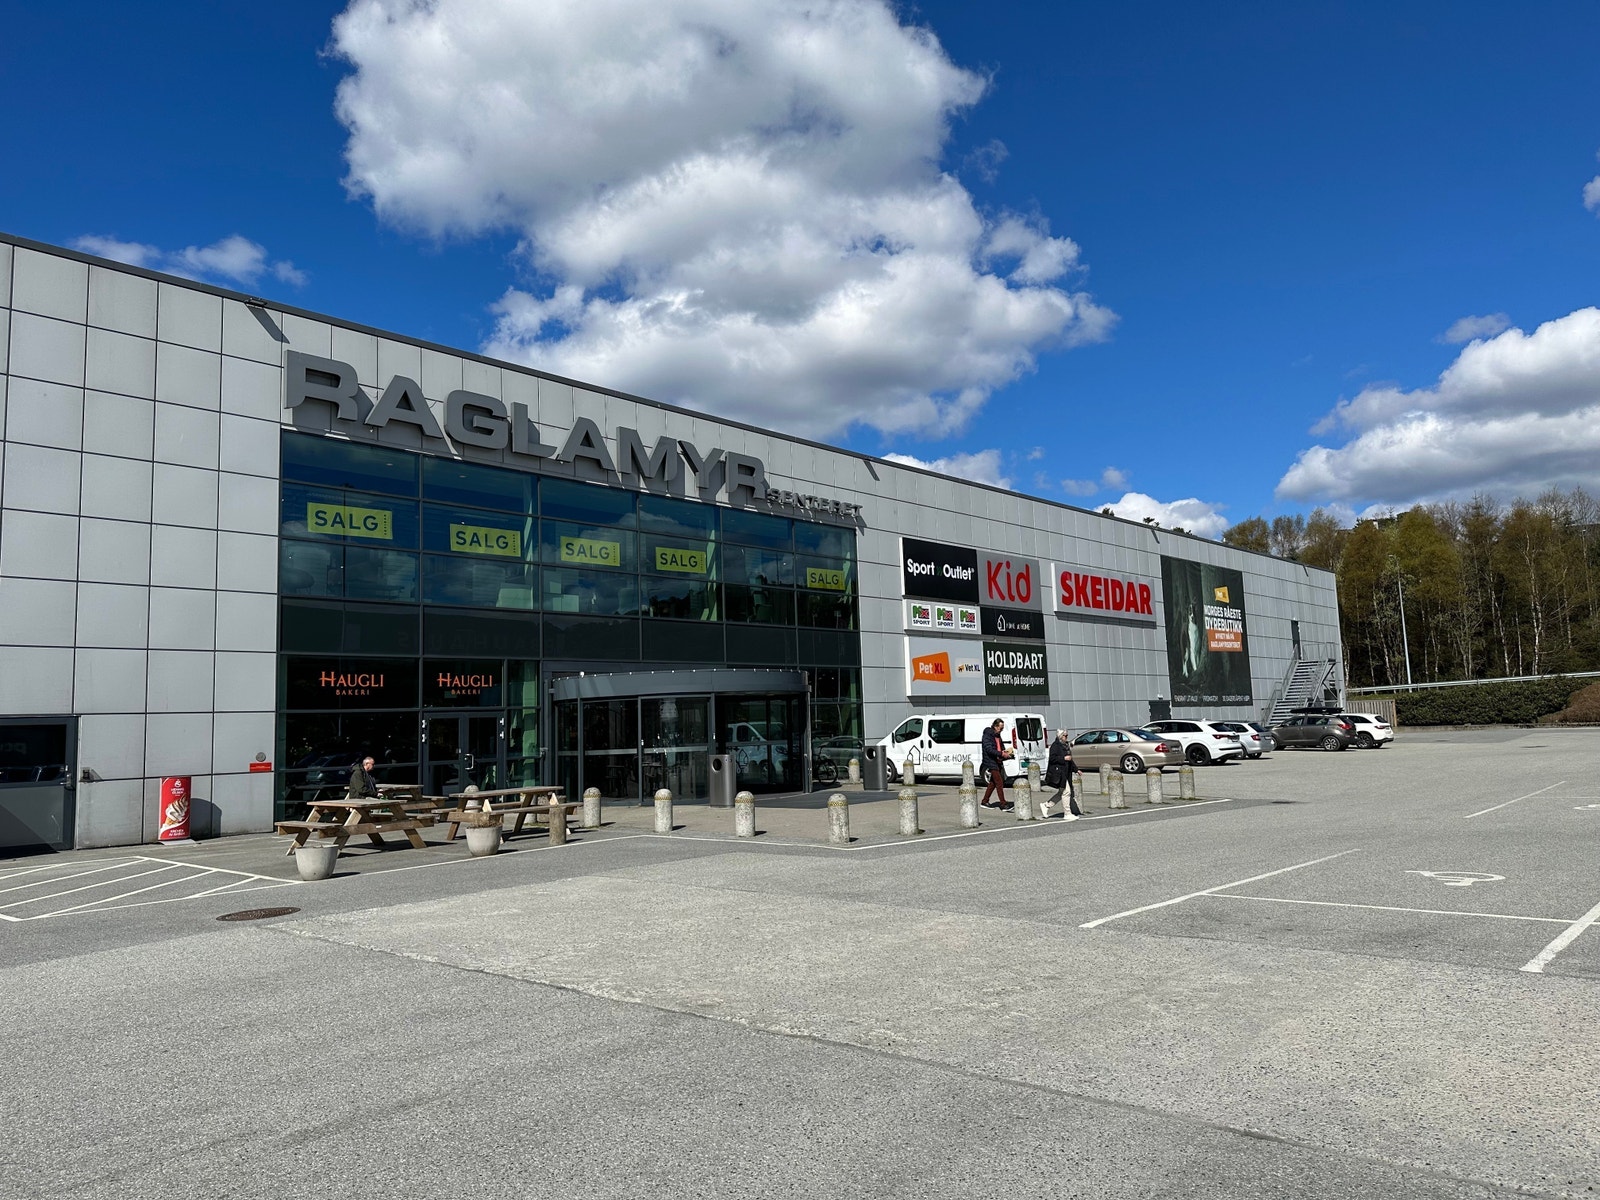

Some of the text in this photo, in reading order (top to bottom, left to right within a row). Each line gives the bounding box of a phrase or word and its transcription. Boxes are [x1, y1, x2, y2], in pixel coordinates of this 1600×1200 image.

[284, 349, 767, 498] RAGLAMYR
[767, 488, 863, 517] SENTERET
[313, 508, 379, 533] SALG
[454, 529, 508, 550] SALG
[564, 541, 608, 560] SALG
[659, 551, 698, 568] SALG
[810, 571, 839, 586] SALG
[907, 558, 972, 581] Sport Outlet
[986, 560, 1031, 604] Kid
[1060, 571, 1153, 615] SKEIDAR
[918, 662, 944, 675] Pet XL
[964, 663, 981, 672] Vet XL
[986, 650, 1043, 670] HOLDBART
[318, 671, 384, 687] HAUGLI
[436, 672, 492, 688] HAUGLI
[922, 752, 940, 763] HOME
